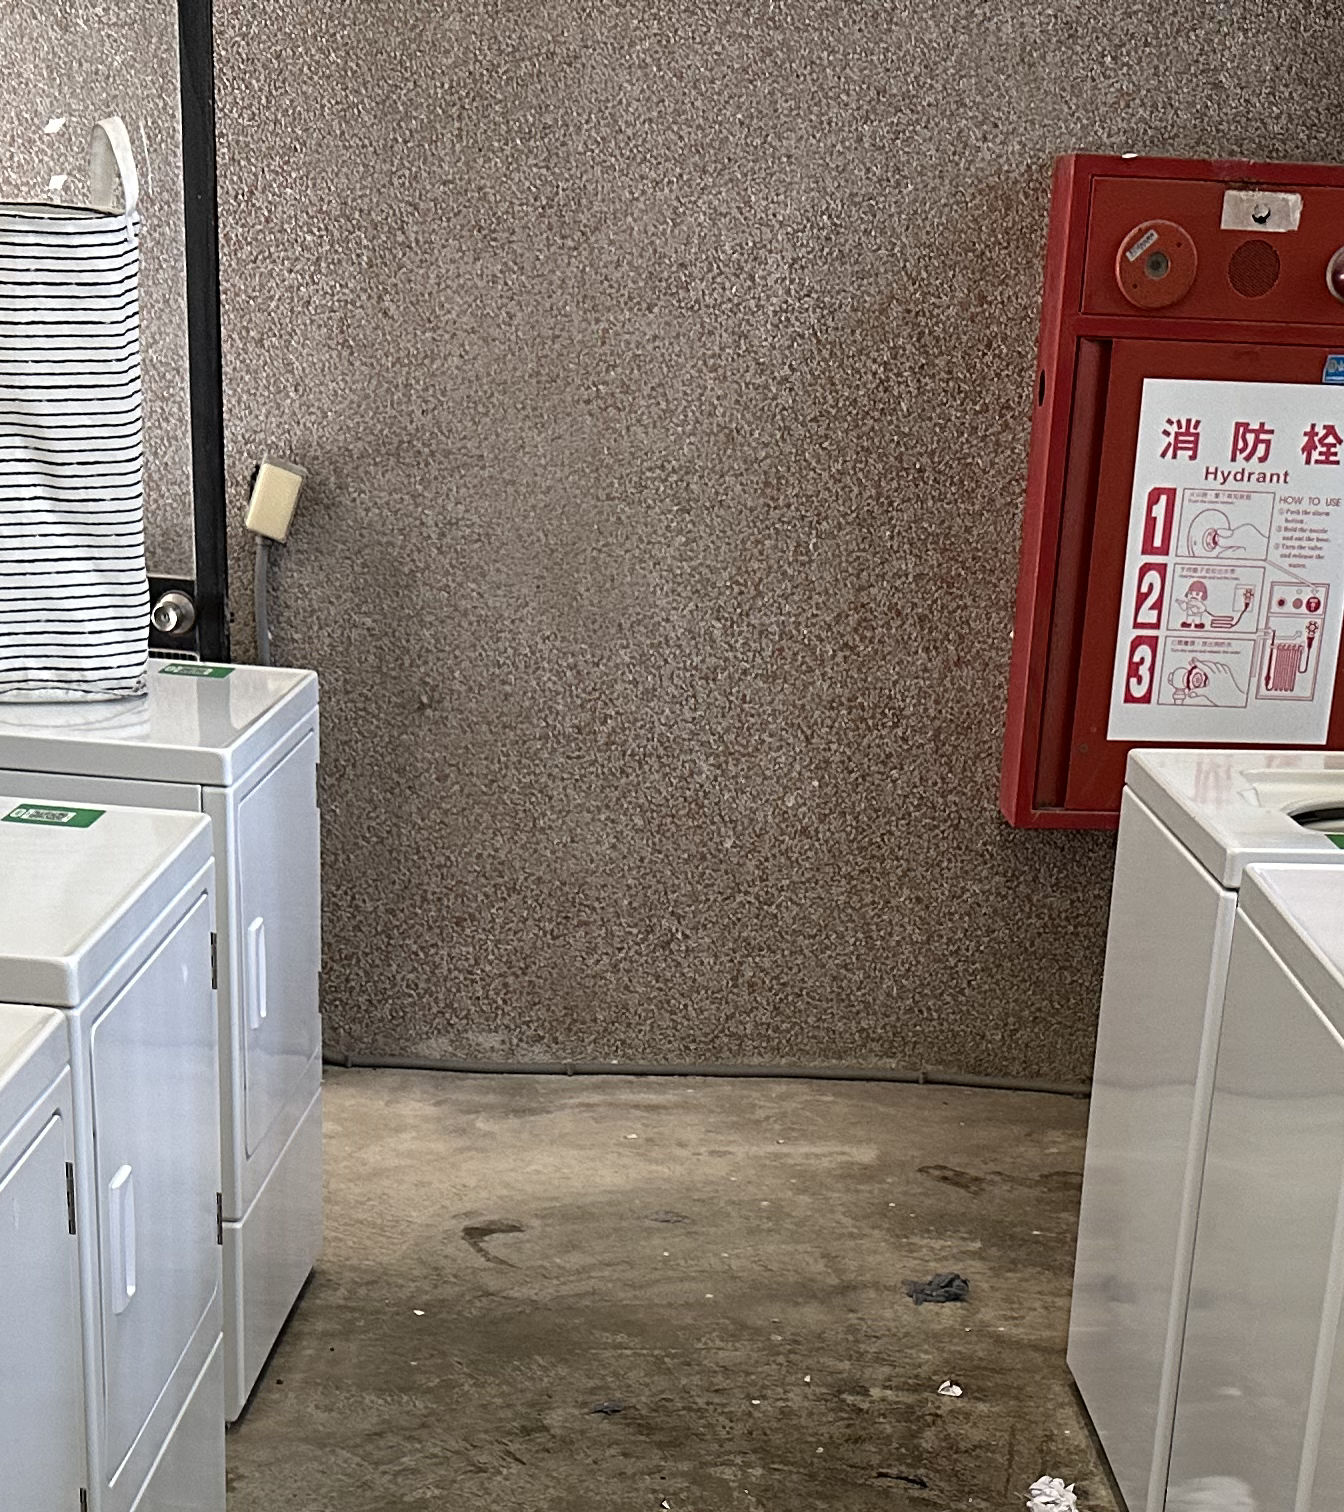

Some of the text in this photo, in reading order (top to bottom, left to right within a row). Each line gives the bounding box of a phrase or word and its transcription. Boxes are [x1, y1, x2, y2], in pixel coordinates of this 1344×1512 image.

[1159, 417, 1344, 466] 消防栓
[1204, 465, 1290, 485] Hydrant
[1151, 494, 1167, 548] 1
[1279, 496, 1342, 507] HOW TO USE
[1136, 570, 1162, 624] 2
[1129, 644, 1153, 699] 3
